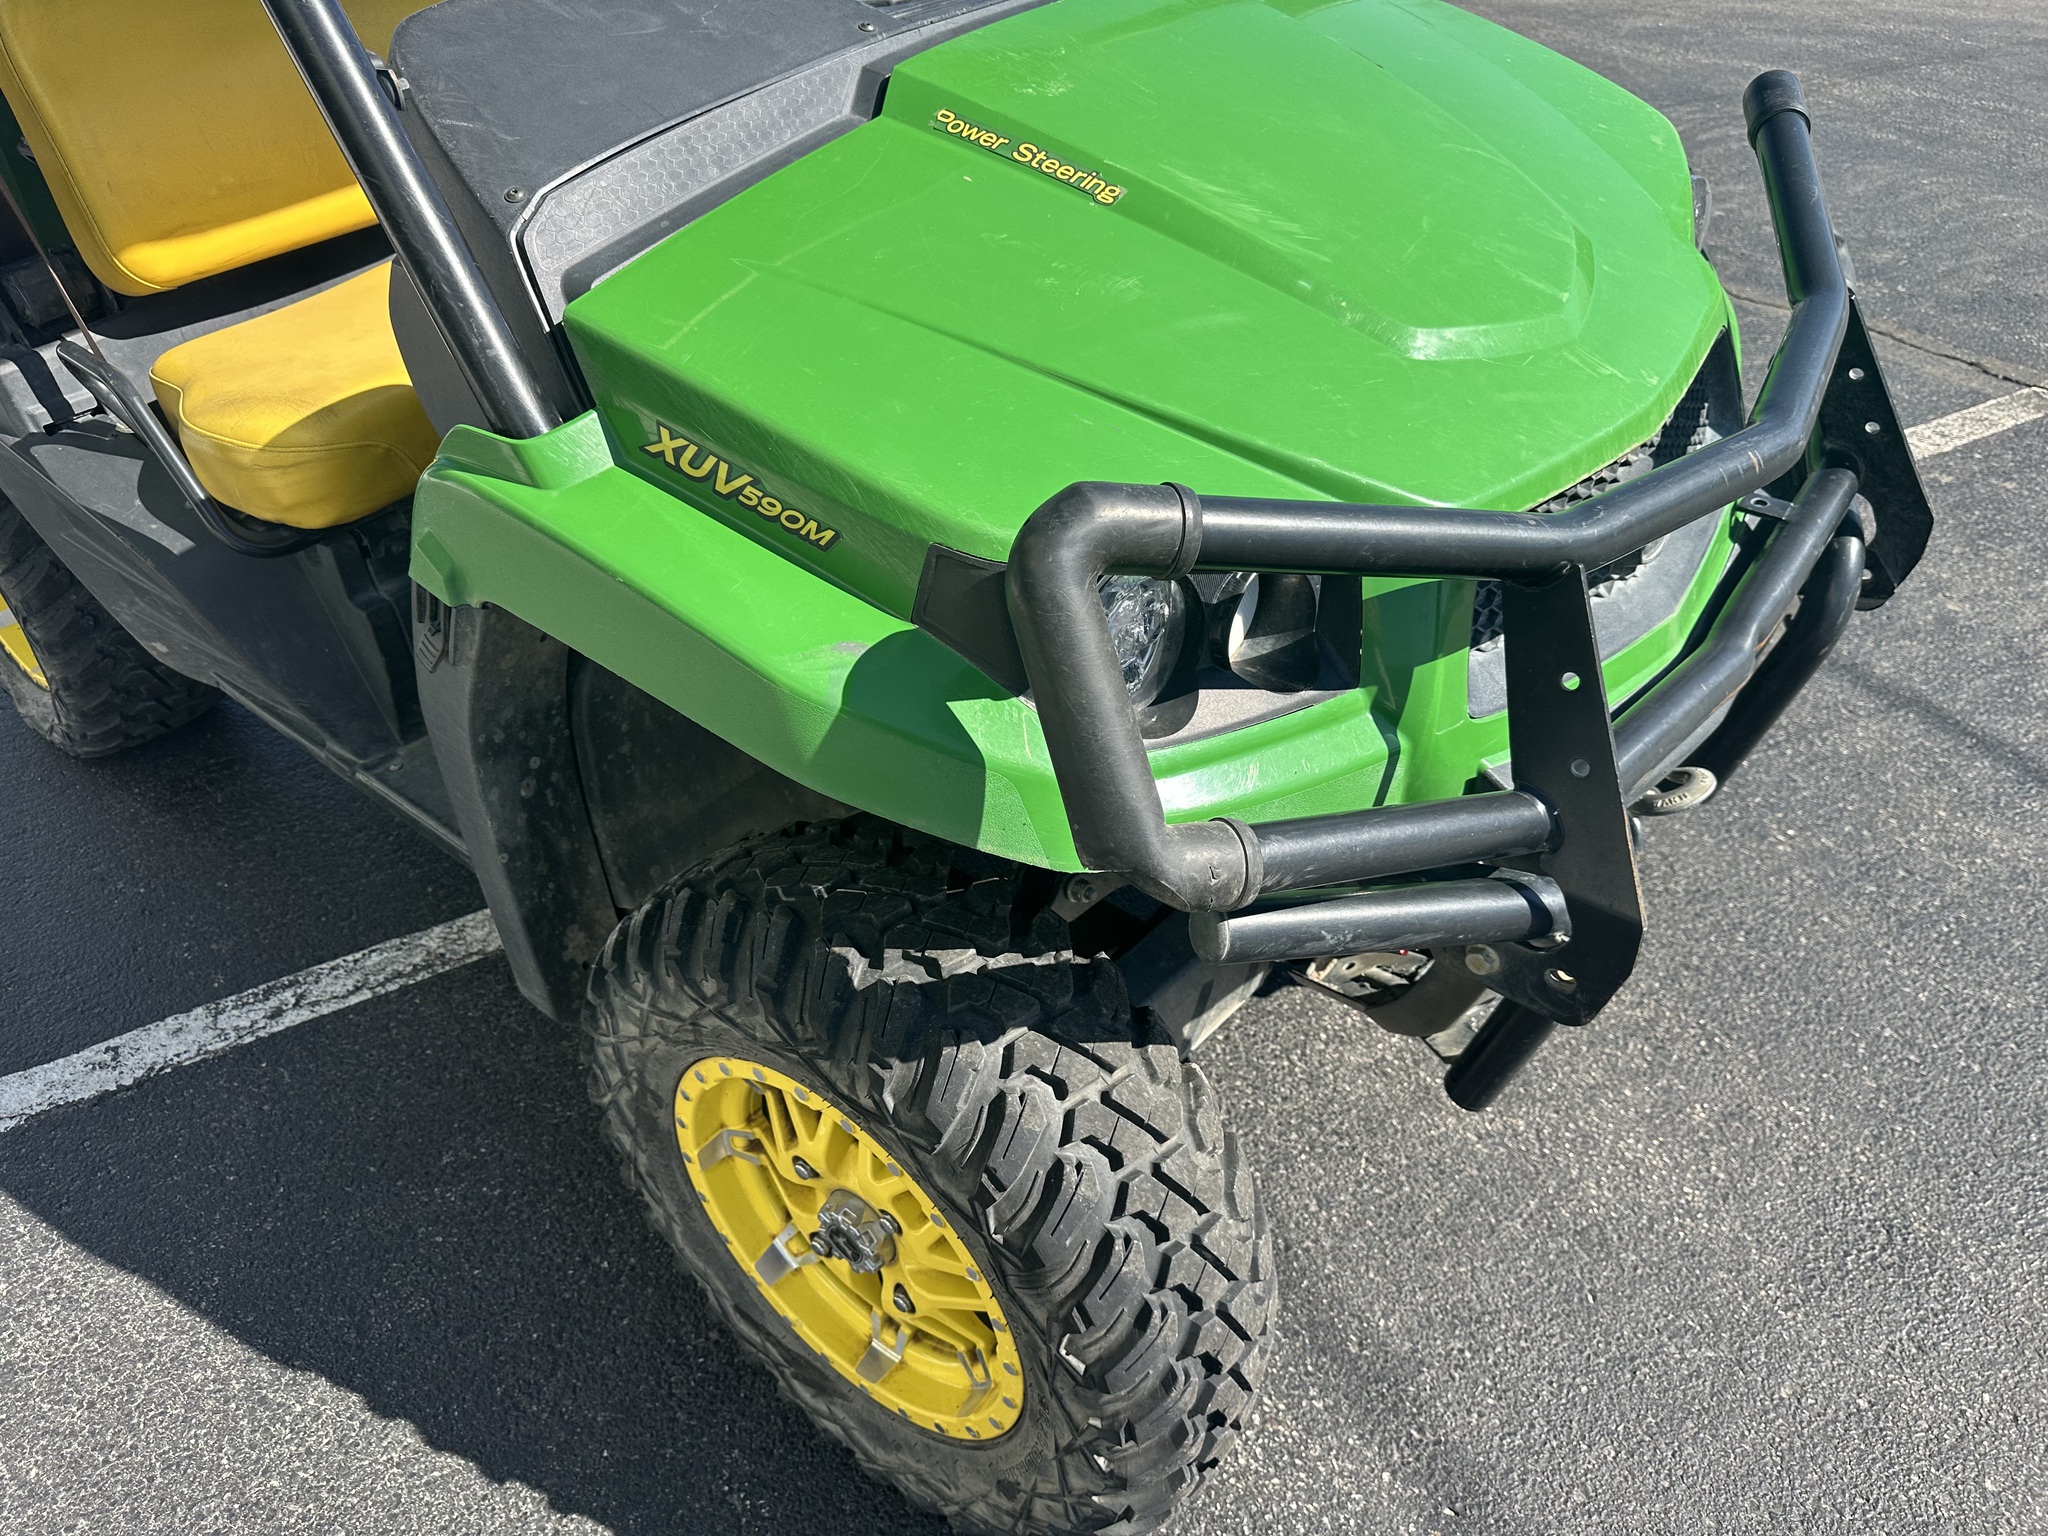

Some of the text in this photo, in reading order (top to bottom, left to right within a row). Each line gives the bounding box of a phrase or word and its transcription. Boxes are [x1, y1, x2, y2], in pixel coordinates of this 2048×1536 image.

[936, 108, 1121, 205] Power Steering
[642, 423, 837, 549] XUV590M
